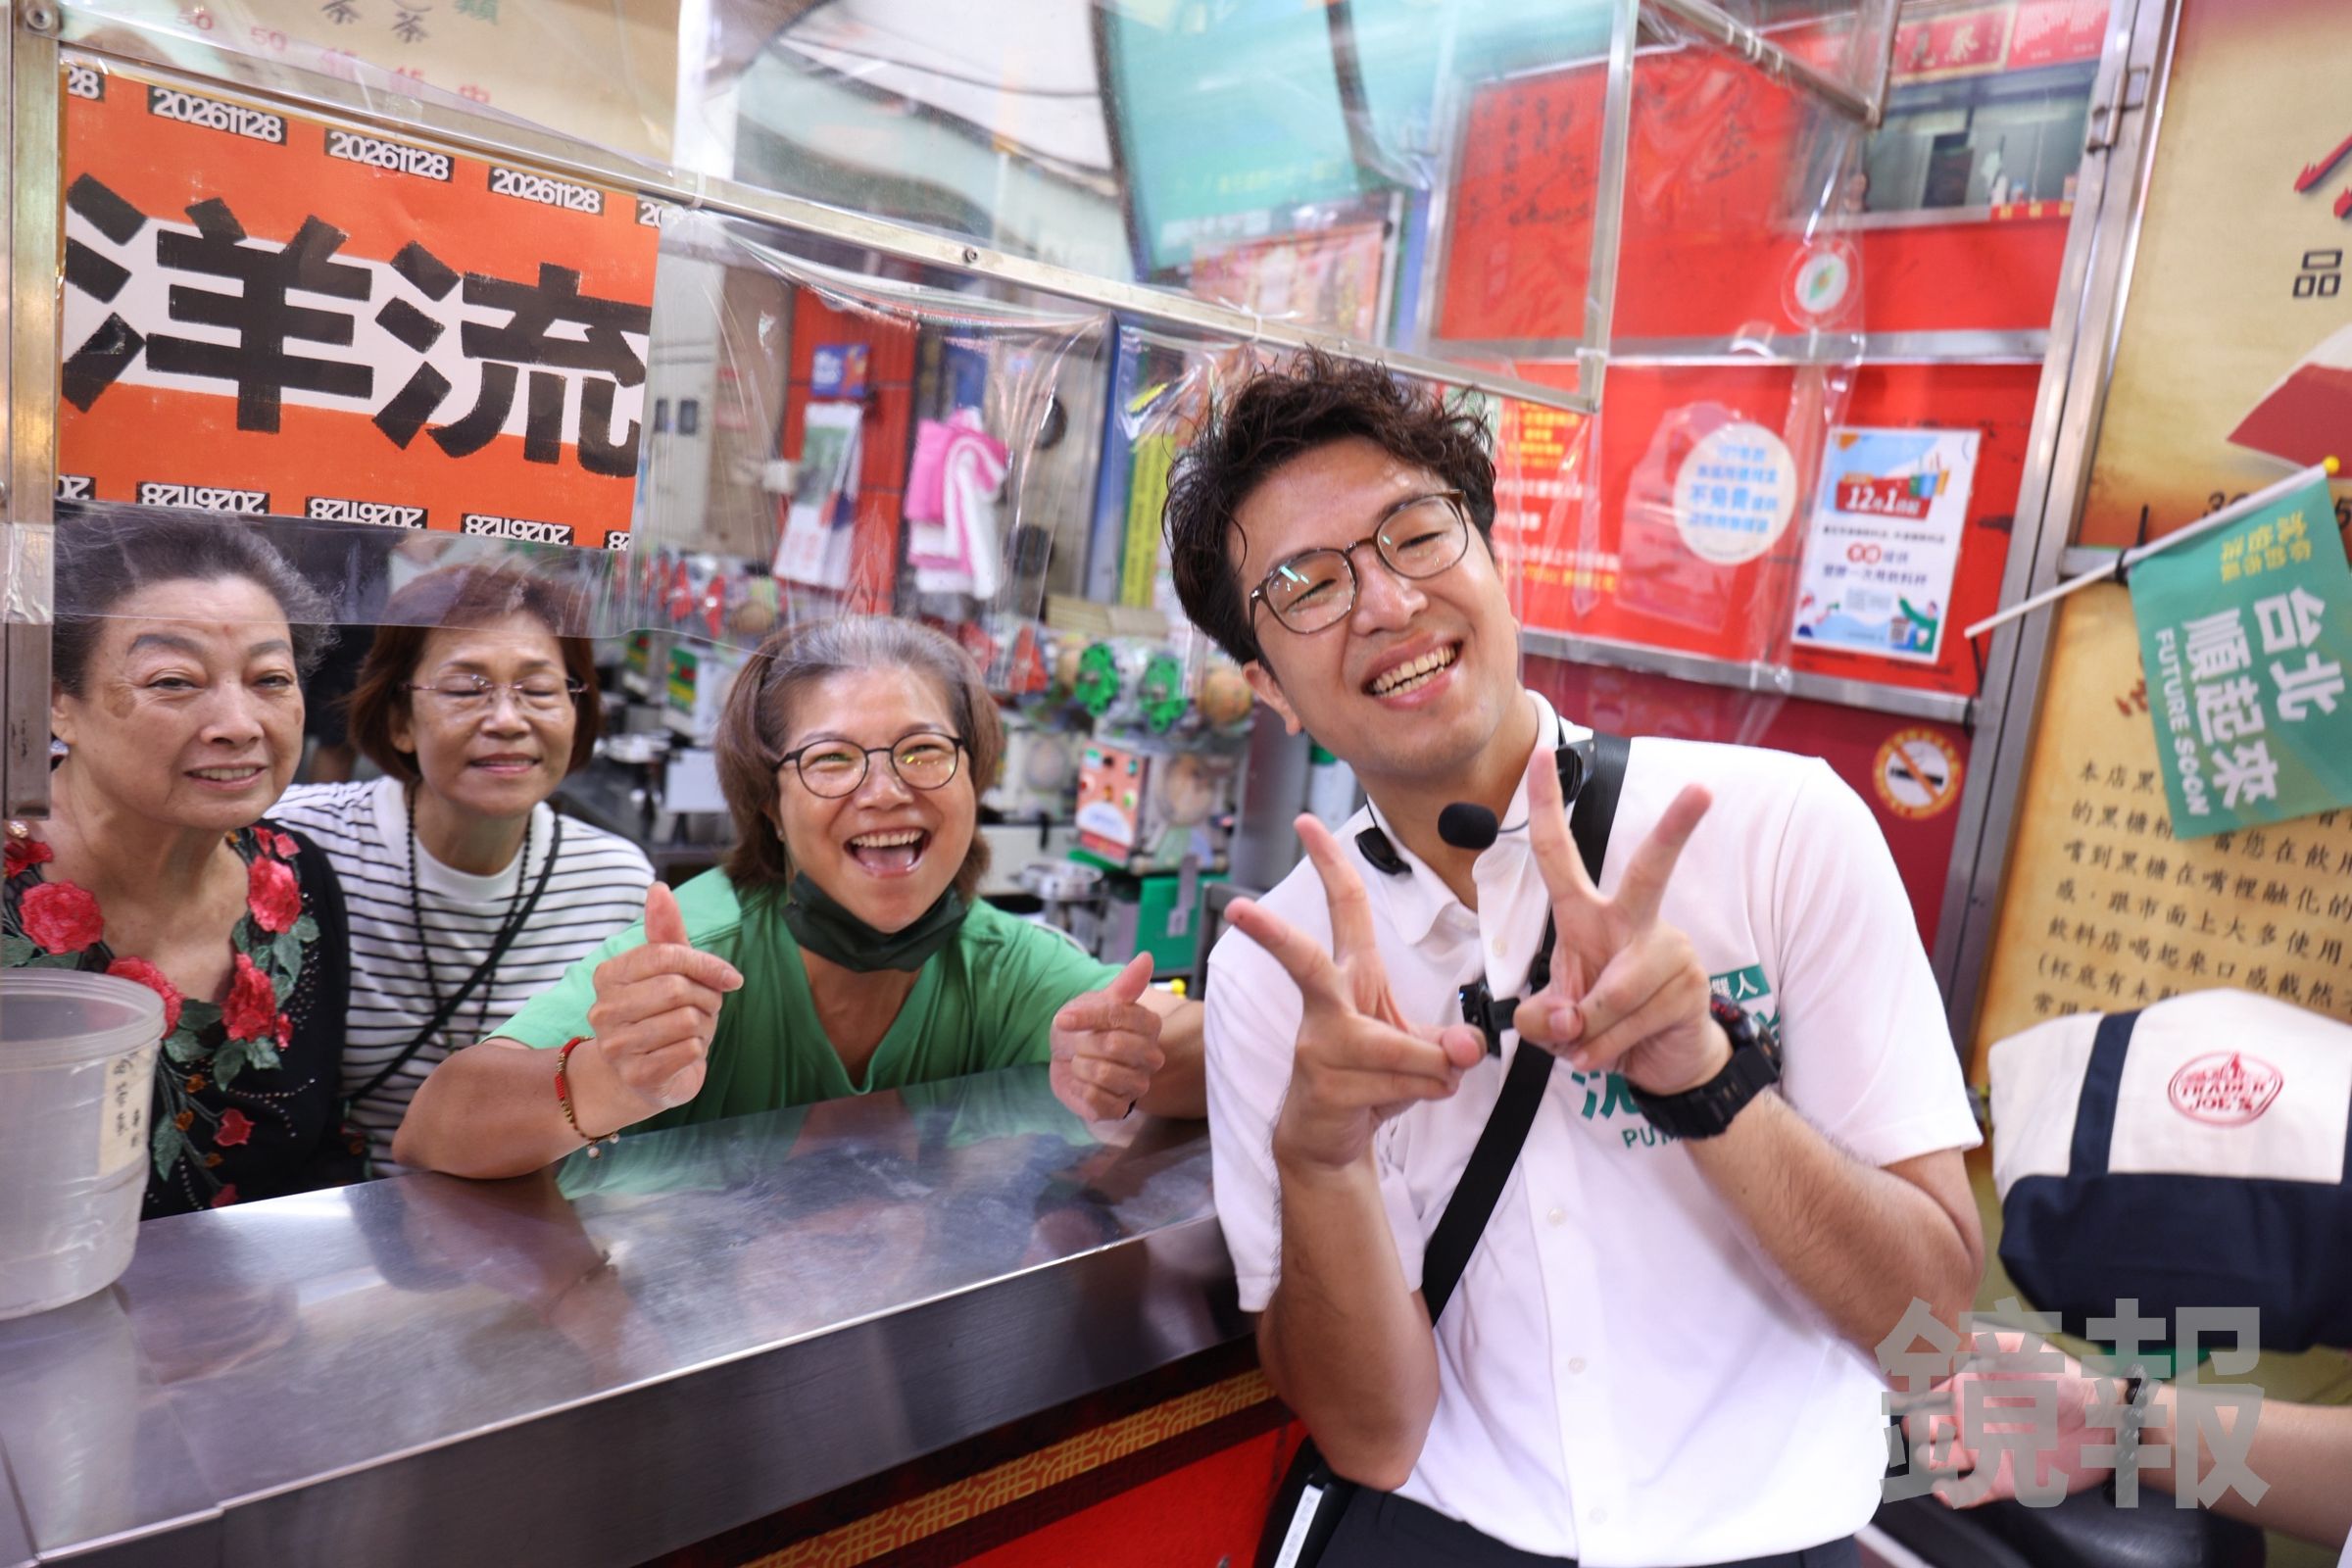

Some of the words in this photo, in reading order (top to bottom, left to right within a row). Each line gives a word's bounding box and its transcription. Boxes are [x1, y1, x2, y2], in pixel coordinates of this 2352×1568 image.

[153, 88, 282, 143] 20261128
[329, 131, 450, 181] 20261128
[492, 168, 601, 215] 20261128
[2292, 248, 2343, 298] 品
[61, 172, 654, 478] 洋流
[2253, 585, 2346, 722] 台北
[2155, 626, 2191, 733] FUTURE
[2173, 736, 2211, 816] SOON
[2180, 607, 2279, 811] 順起來
